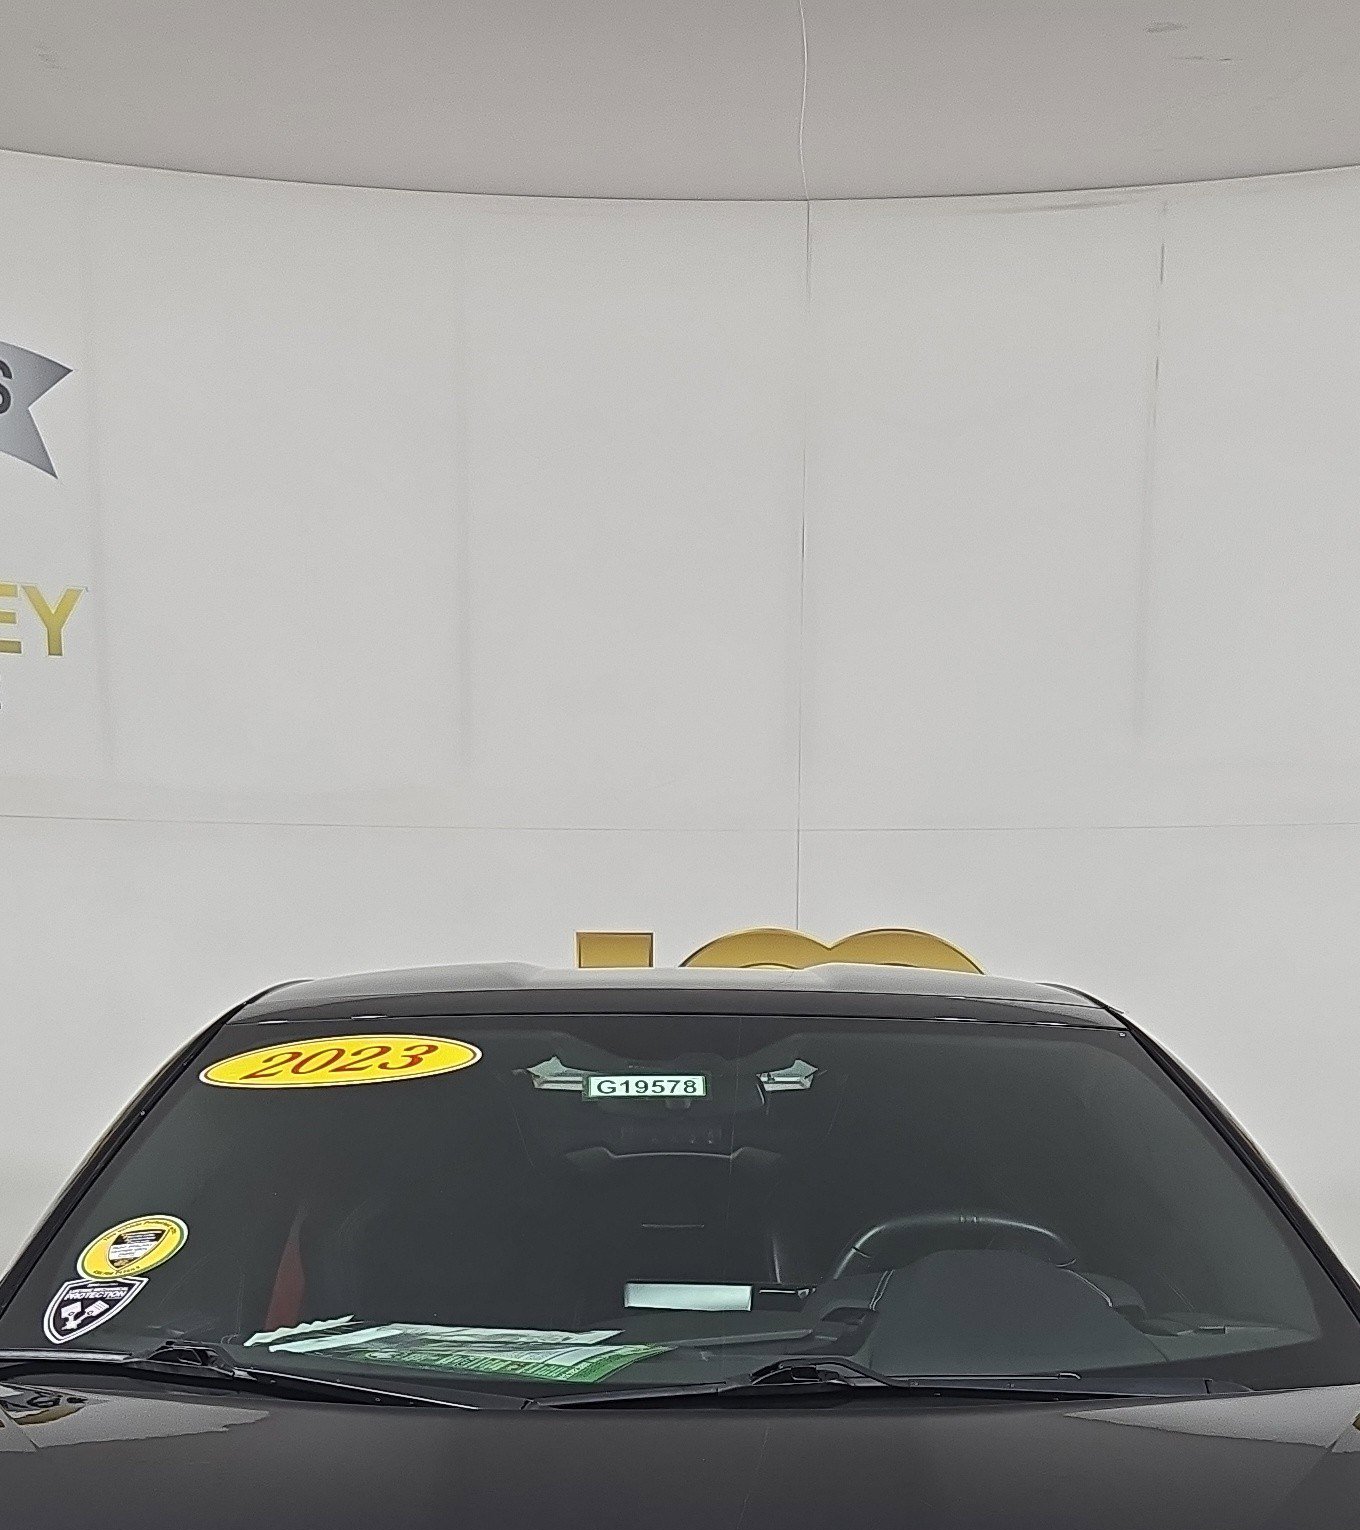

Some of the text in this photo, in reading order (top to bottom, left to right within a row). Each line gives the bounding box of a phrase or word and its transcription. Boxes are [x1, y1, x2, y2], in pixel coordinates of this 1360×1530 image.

[239, 1043, 439, 1081] 2023
[596, 1079, 698, 1094] G19578
[64, 1290, 128, 1300] PROTECTION
